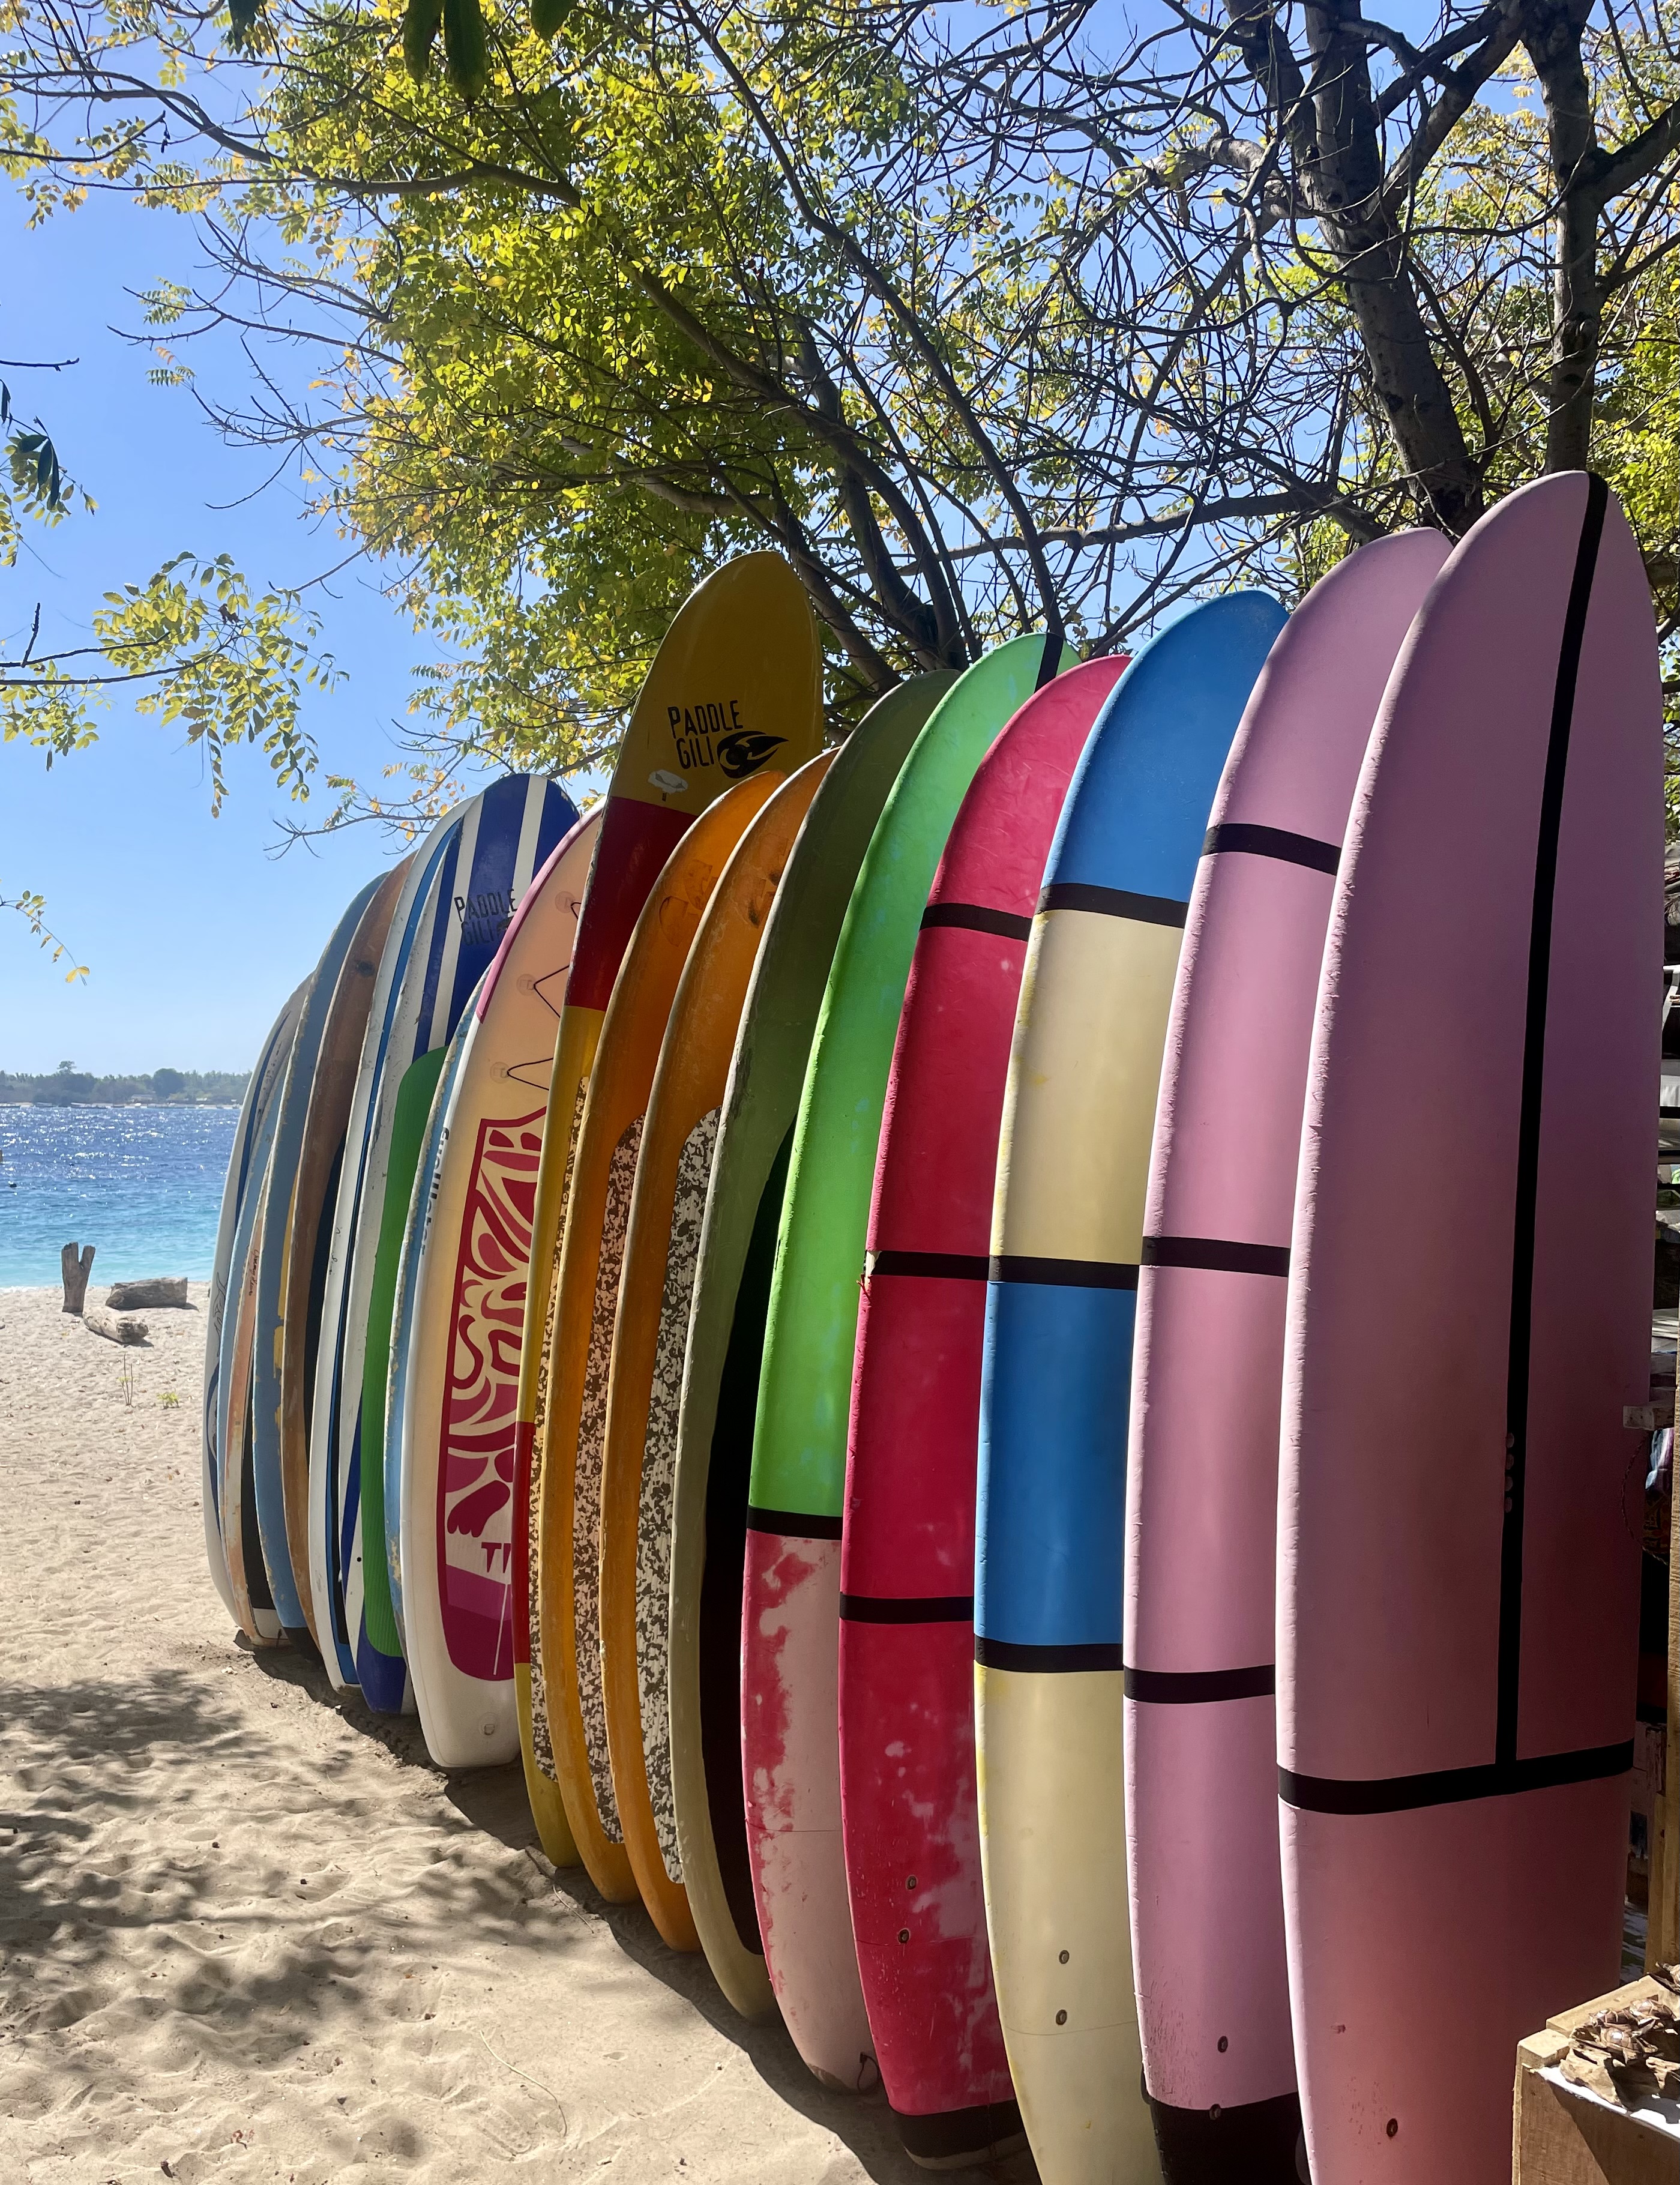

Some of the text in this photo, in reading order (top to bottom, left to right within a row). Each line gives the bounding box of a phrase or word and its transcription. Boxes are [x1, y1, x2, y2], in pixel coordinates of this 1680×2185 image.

[667, 700, 744, 739] PADDLE
[676, 736, 714, 770] GILI
[454, 888, 517, 923] PADDLE
[461, 918, 495, 946] GILI
